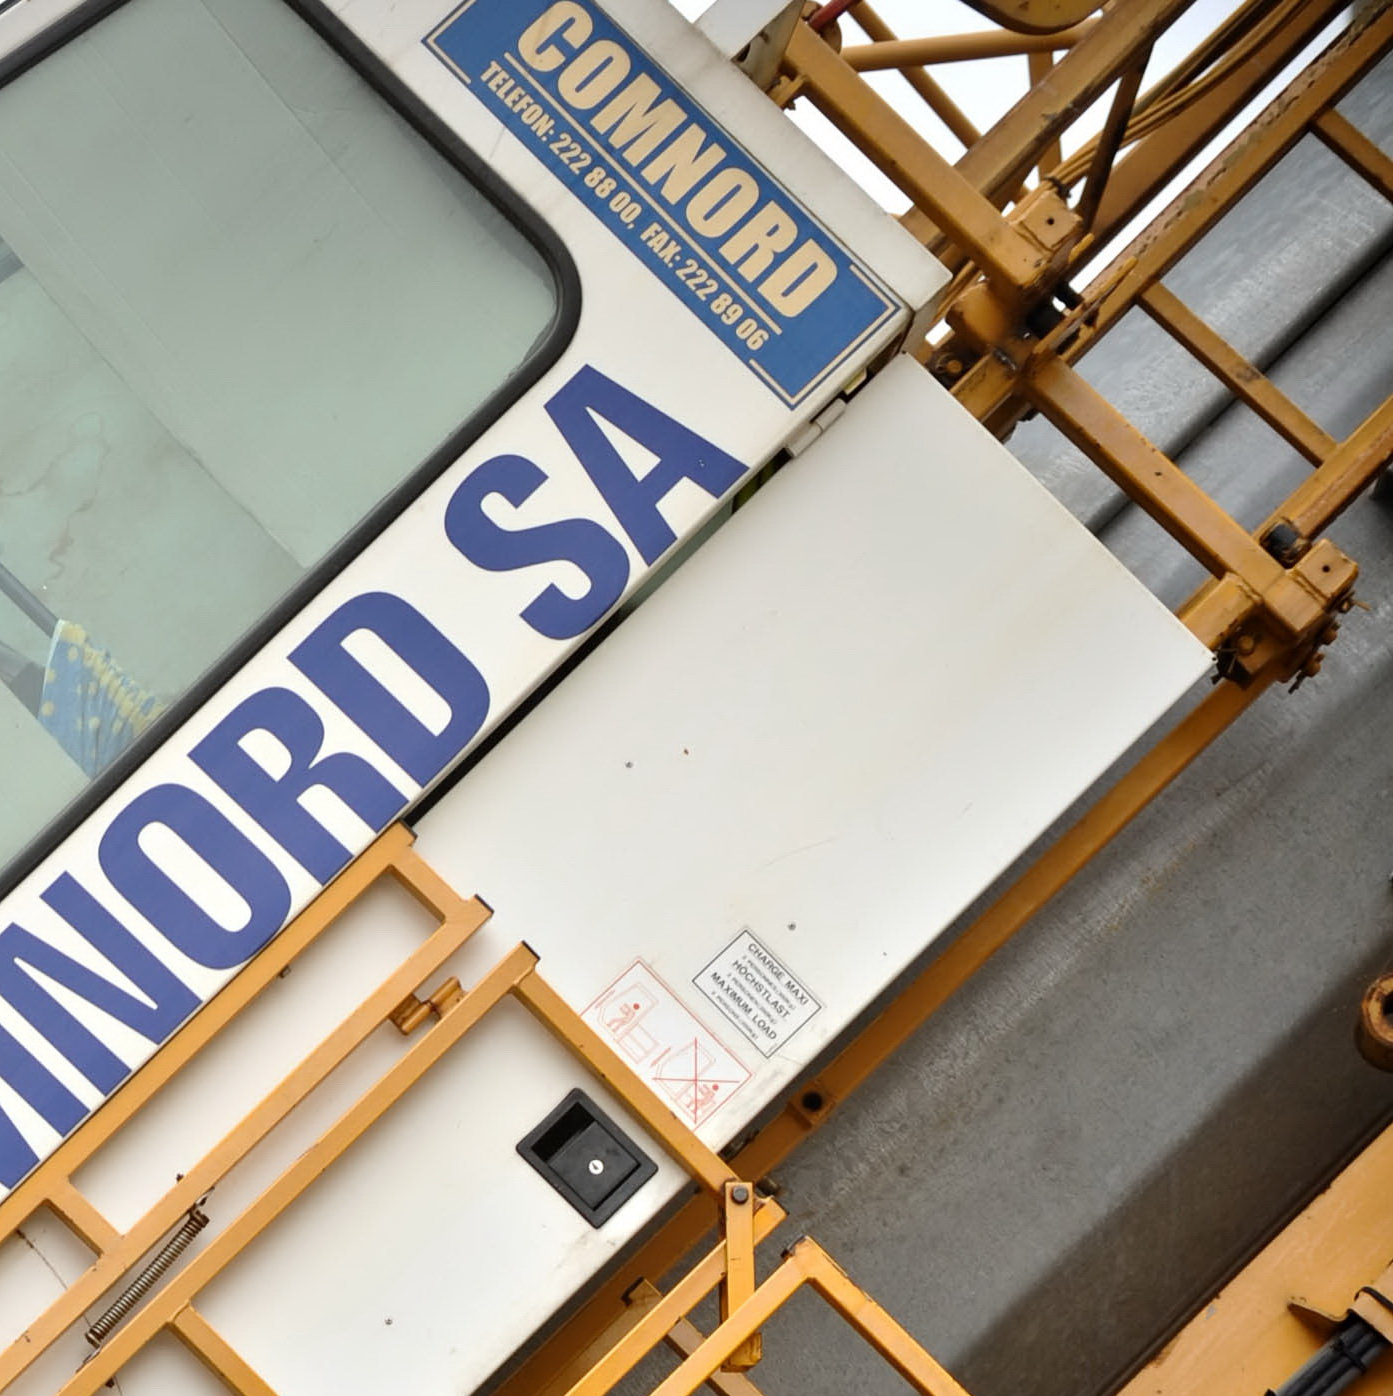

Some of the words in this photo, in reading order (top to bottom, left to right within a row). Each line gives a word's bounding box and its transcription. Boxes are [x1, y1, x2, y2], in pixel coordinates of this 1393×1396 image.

[481, 60, 555, 142] TELEFON:
[549, 132, 592, 174] 222
[583, 166, 617, 199] 88
[609, 191, 642, 229] 00,
[640, 222, 681, 268] FAX:
[675, 259, 719, 301] 222
[710, 293, 744, 325] 89
[735, 317, 769, 350] 06
[518, 1, 838, 318] COMNORD
[445, 364, 748, 640] SA
[710, 971, 753, 1015] MAXIMUM
[751, 1013, 778, 1040] LOAD
[746, 941, 785, 981] CHARGE
[783, 979, 809, 1005] MAXI
